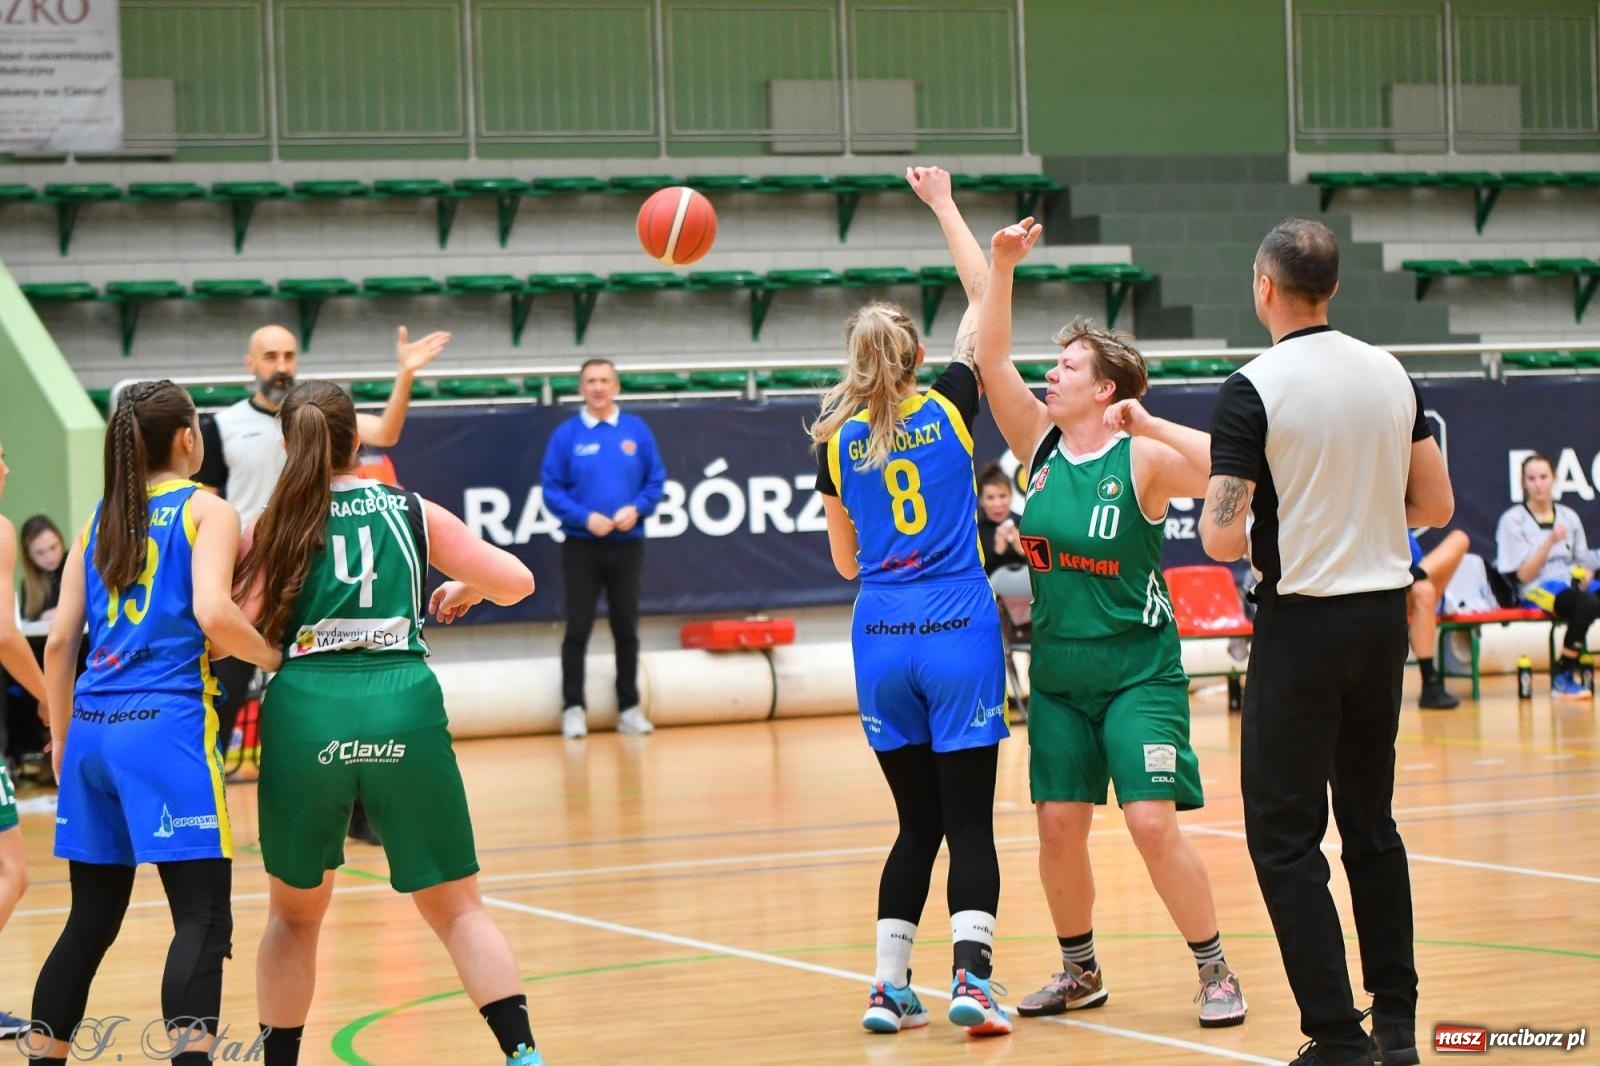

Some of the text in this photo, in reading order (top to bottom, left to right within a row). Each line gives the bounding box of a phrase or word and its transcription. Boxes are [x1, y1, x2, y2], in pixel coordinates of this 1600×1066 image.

[0, 0, 90, 25] ZKO
[330, 491, 409, 518] RACIBÓRZ
[463, 458, 828, 545] RABÓRZ
[884, 458, 928, 536] 8
[1088, 504, 1121, 540] 10
[332, 525, 378, 608] 4
[865, 617, 970, 635] schatt decor
[107, 708, 160, 725] decor
[339, 739, 406, 760] Clavis
